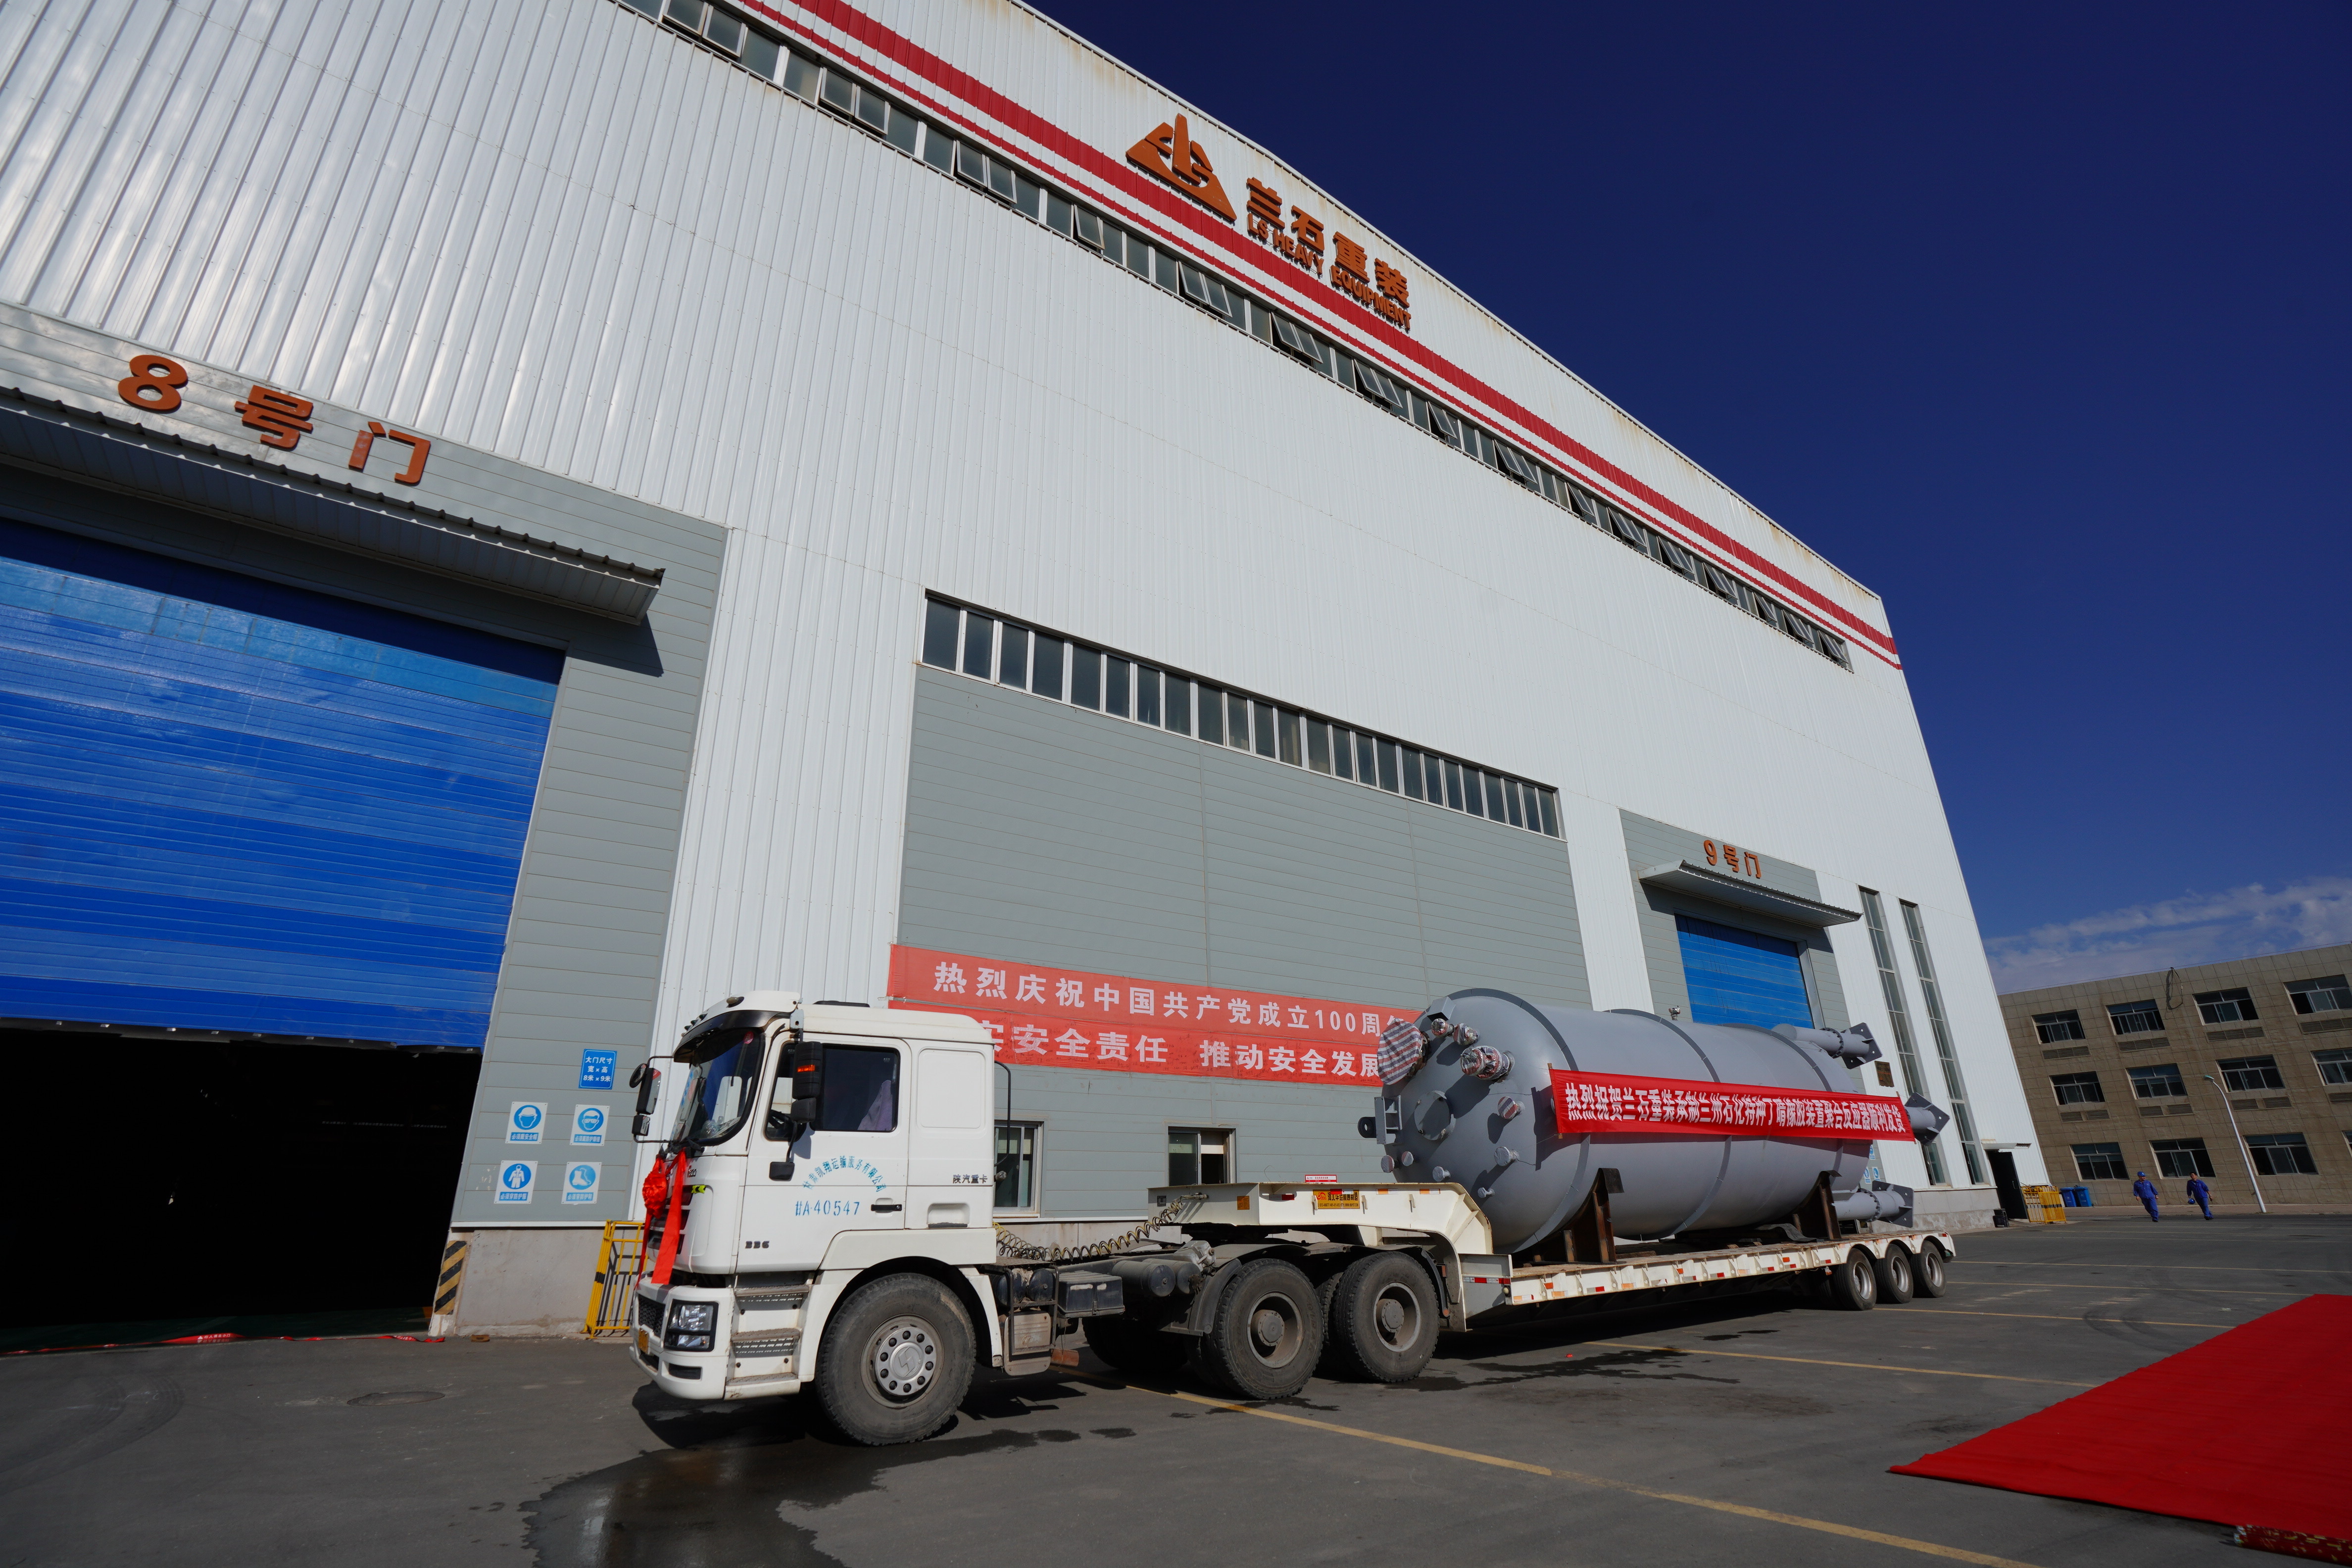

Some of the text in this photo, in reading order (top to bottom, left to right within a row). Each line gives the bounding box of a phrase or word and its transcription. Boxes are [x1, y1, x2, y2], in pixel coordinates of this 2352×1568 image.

[1246, 177, 1410, 308] 兰石重装
[1247, 213, 1411, 330] LS HEAVY EQUIPMENT
[118, 354, 431, 486] 8号门
[1703, 839, 1762, 879] 9号门
[933, 961, 1404, 1037] 热烈庆祝中国共产党成立100周
[953, 1174, 988, 1183] 陕汽重卡
